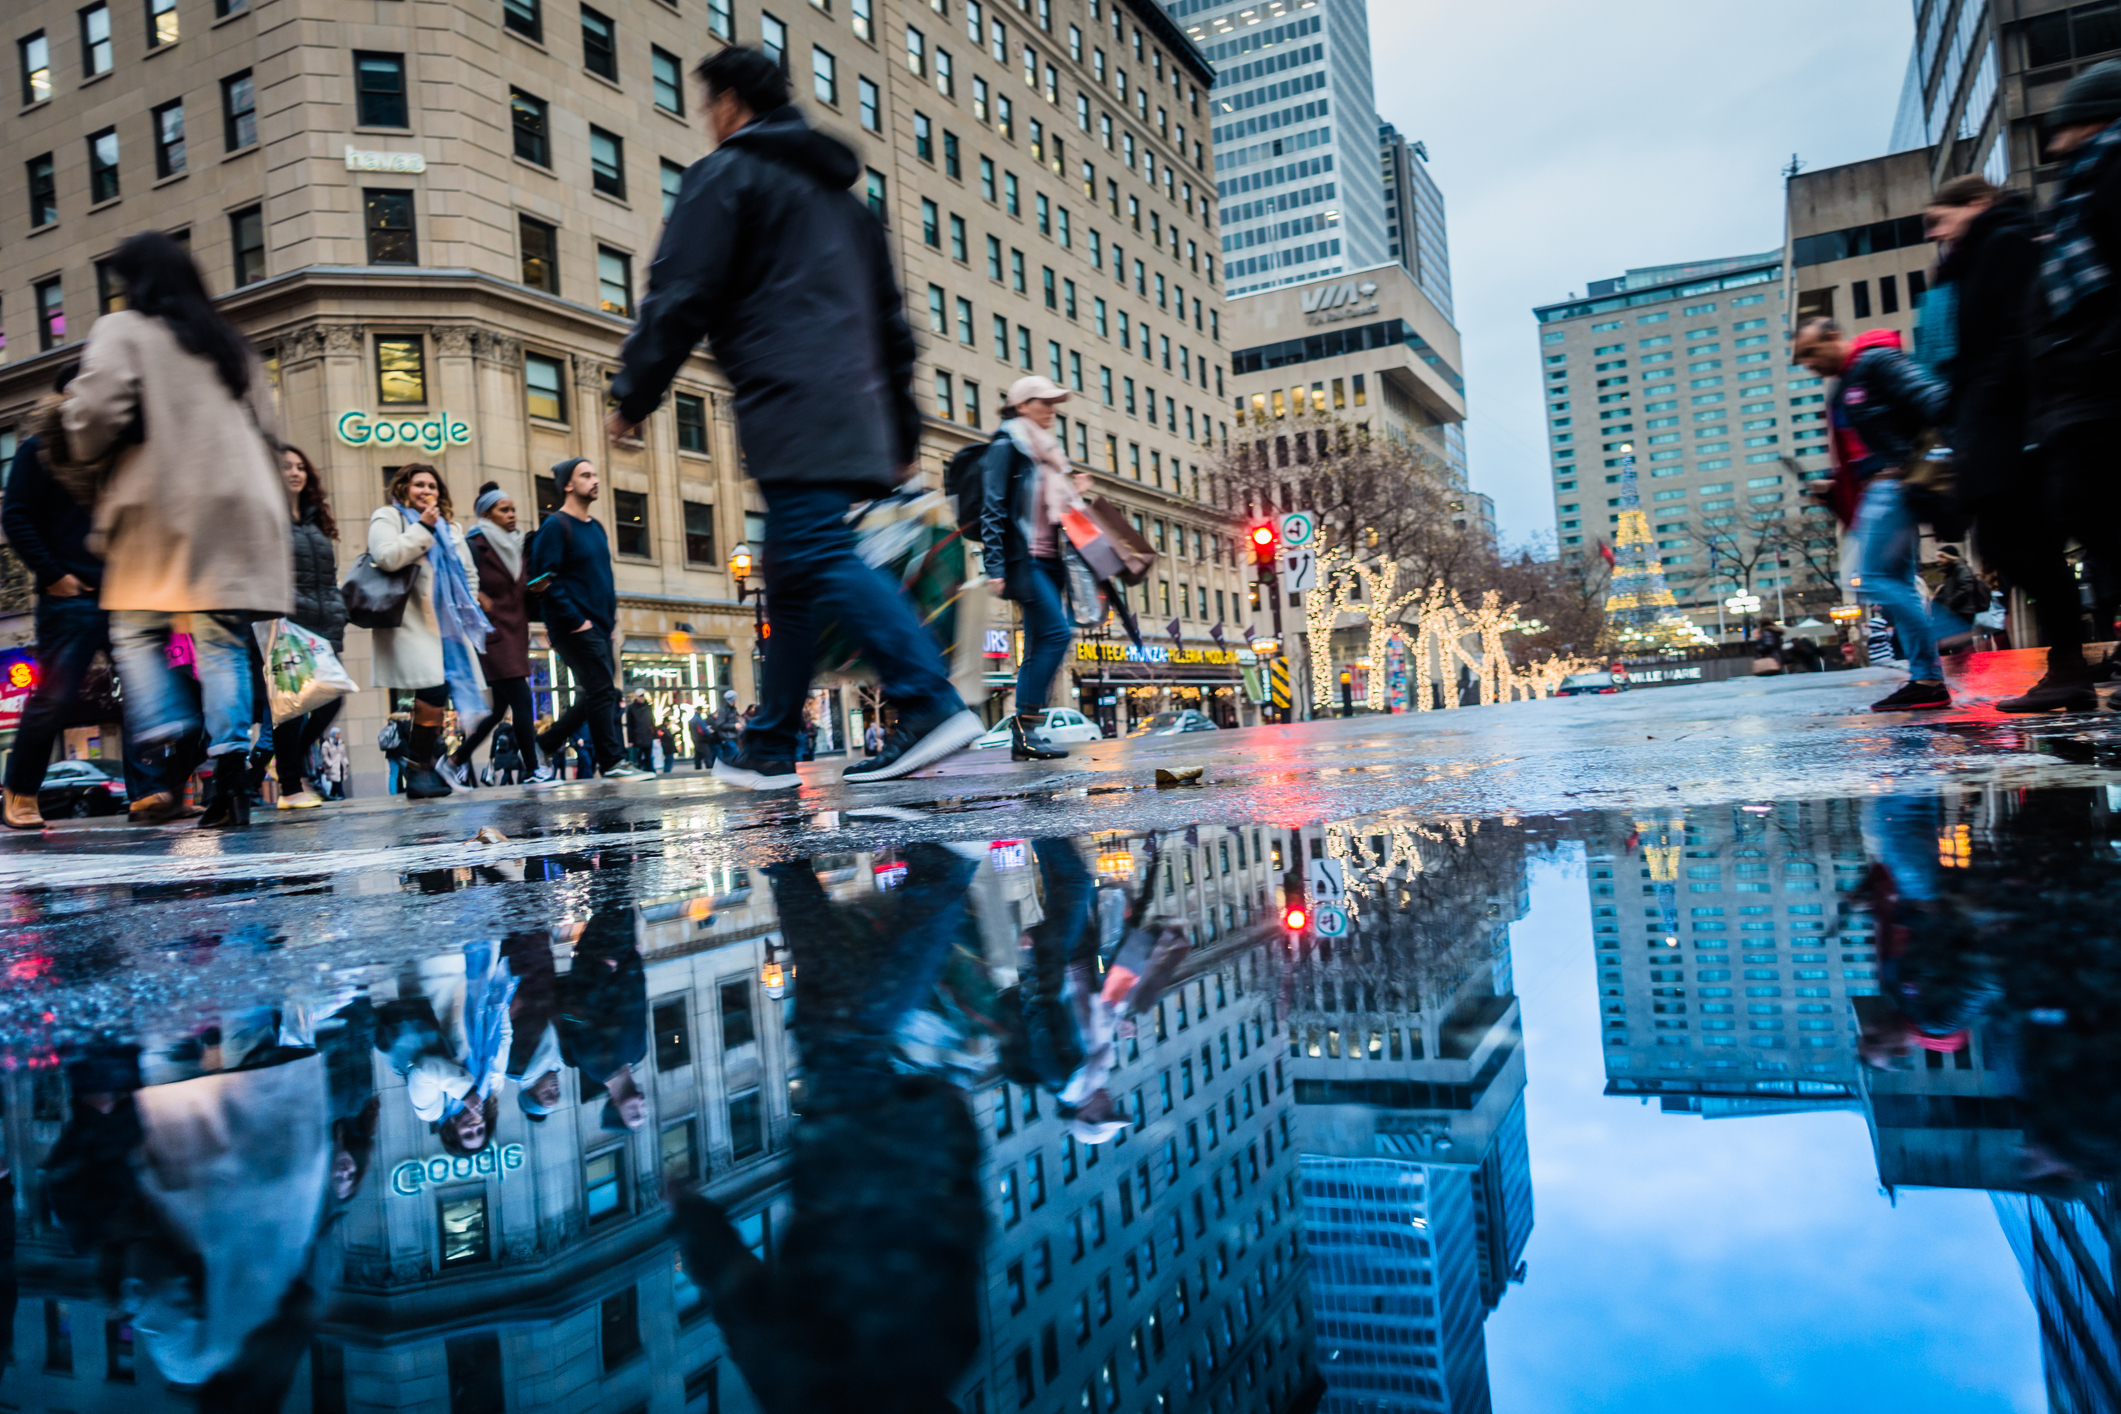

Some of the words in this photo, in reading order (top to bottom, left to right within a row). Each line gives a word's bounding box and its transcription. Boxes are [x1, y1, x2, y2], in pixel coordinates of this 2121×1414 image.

[345, 145, 425, 172] havas
[338, 410, 470, 451] Google
[1628, 671, 1662, 683] VILLE
[1664, 667, 1701, 680] MARIE
